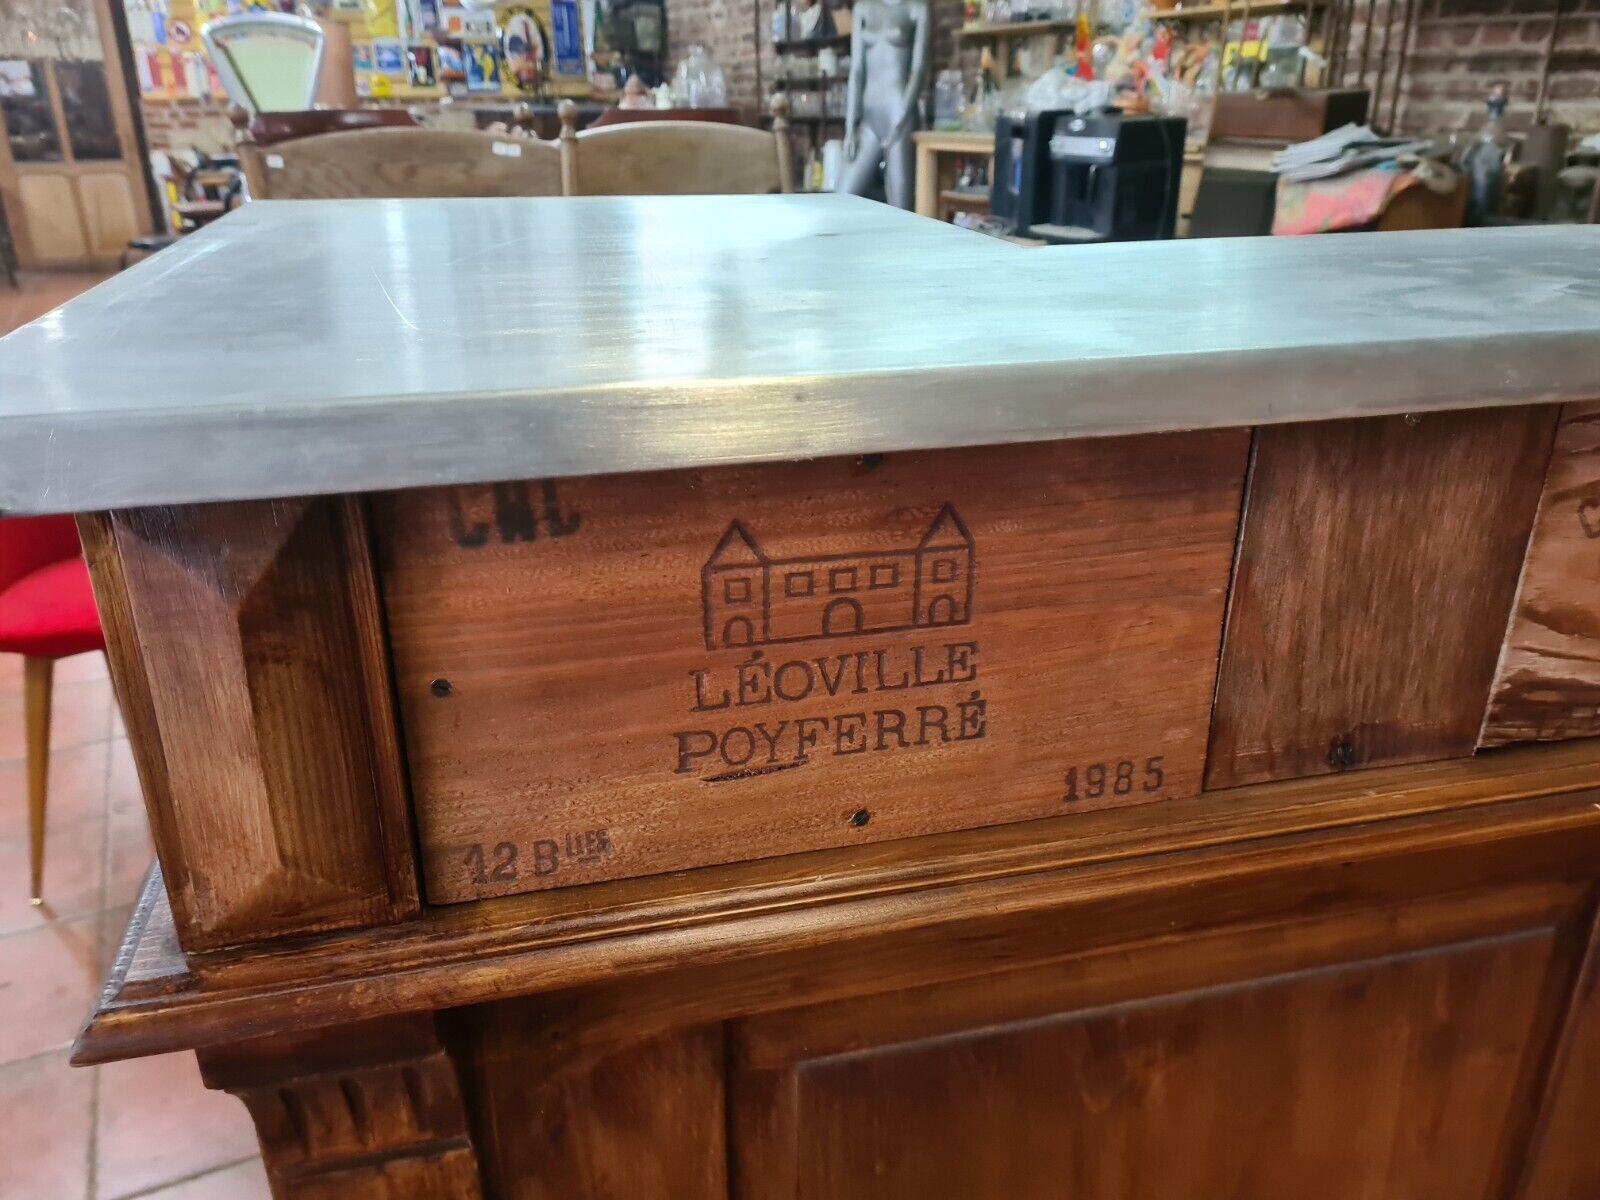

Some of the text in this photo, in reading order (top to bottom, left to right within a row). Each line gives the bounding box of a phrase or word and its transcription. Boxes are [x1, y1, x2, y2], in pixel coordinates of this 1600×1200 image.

[688, 641, 978, 712] LÉOVILLE
[673, 690, 987, 774] POYFERRÉ
[1063, 755, 1165, 803] 1985
[464, 841, 518, 884] 12
